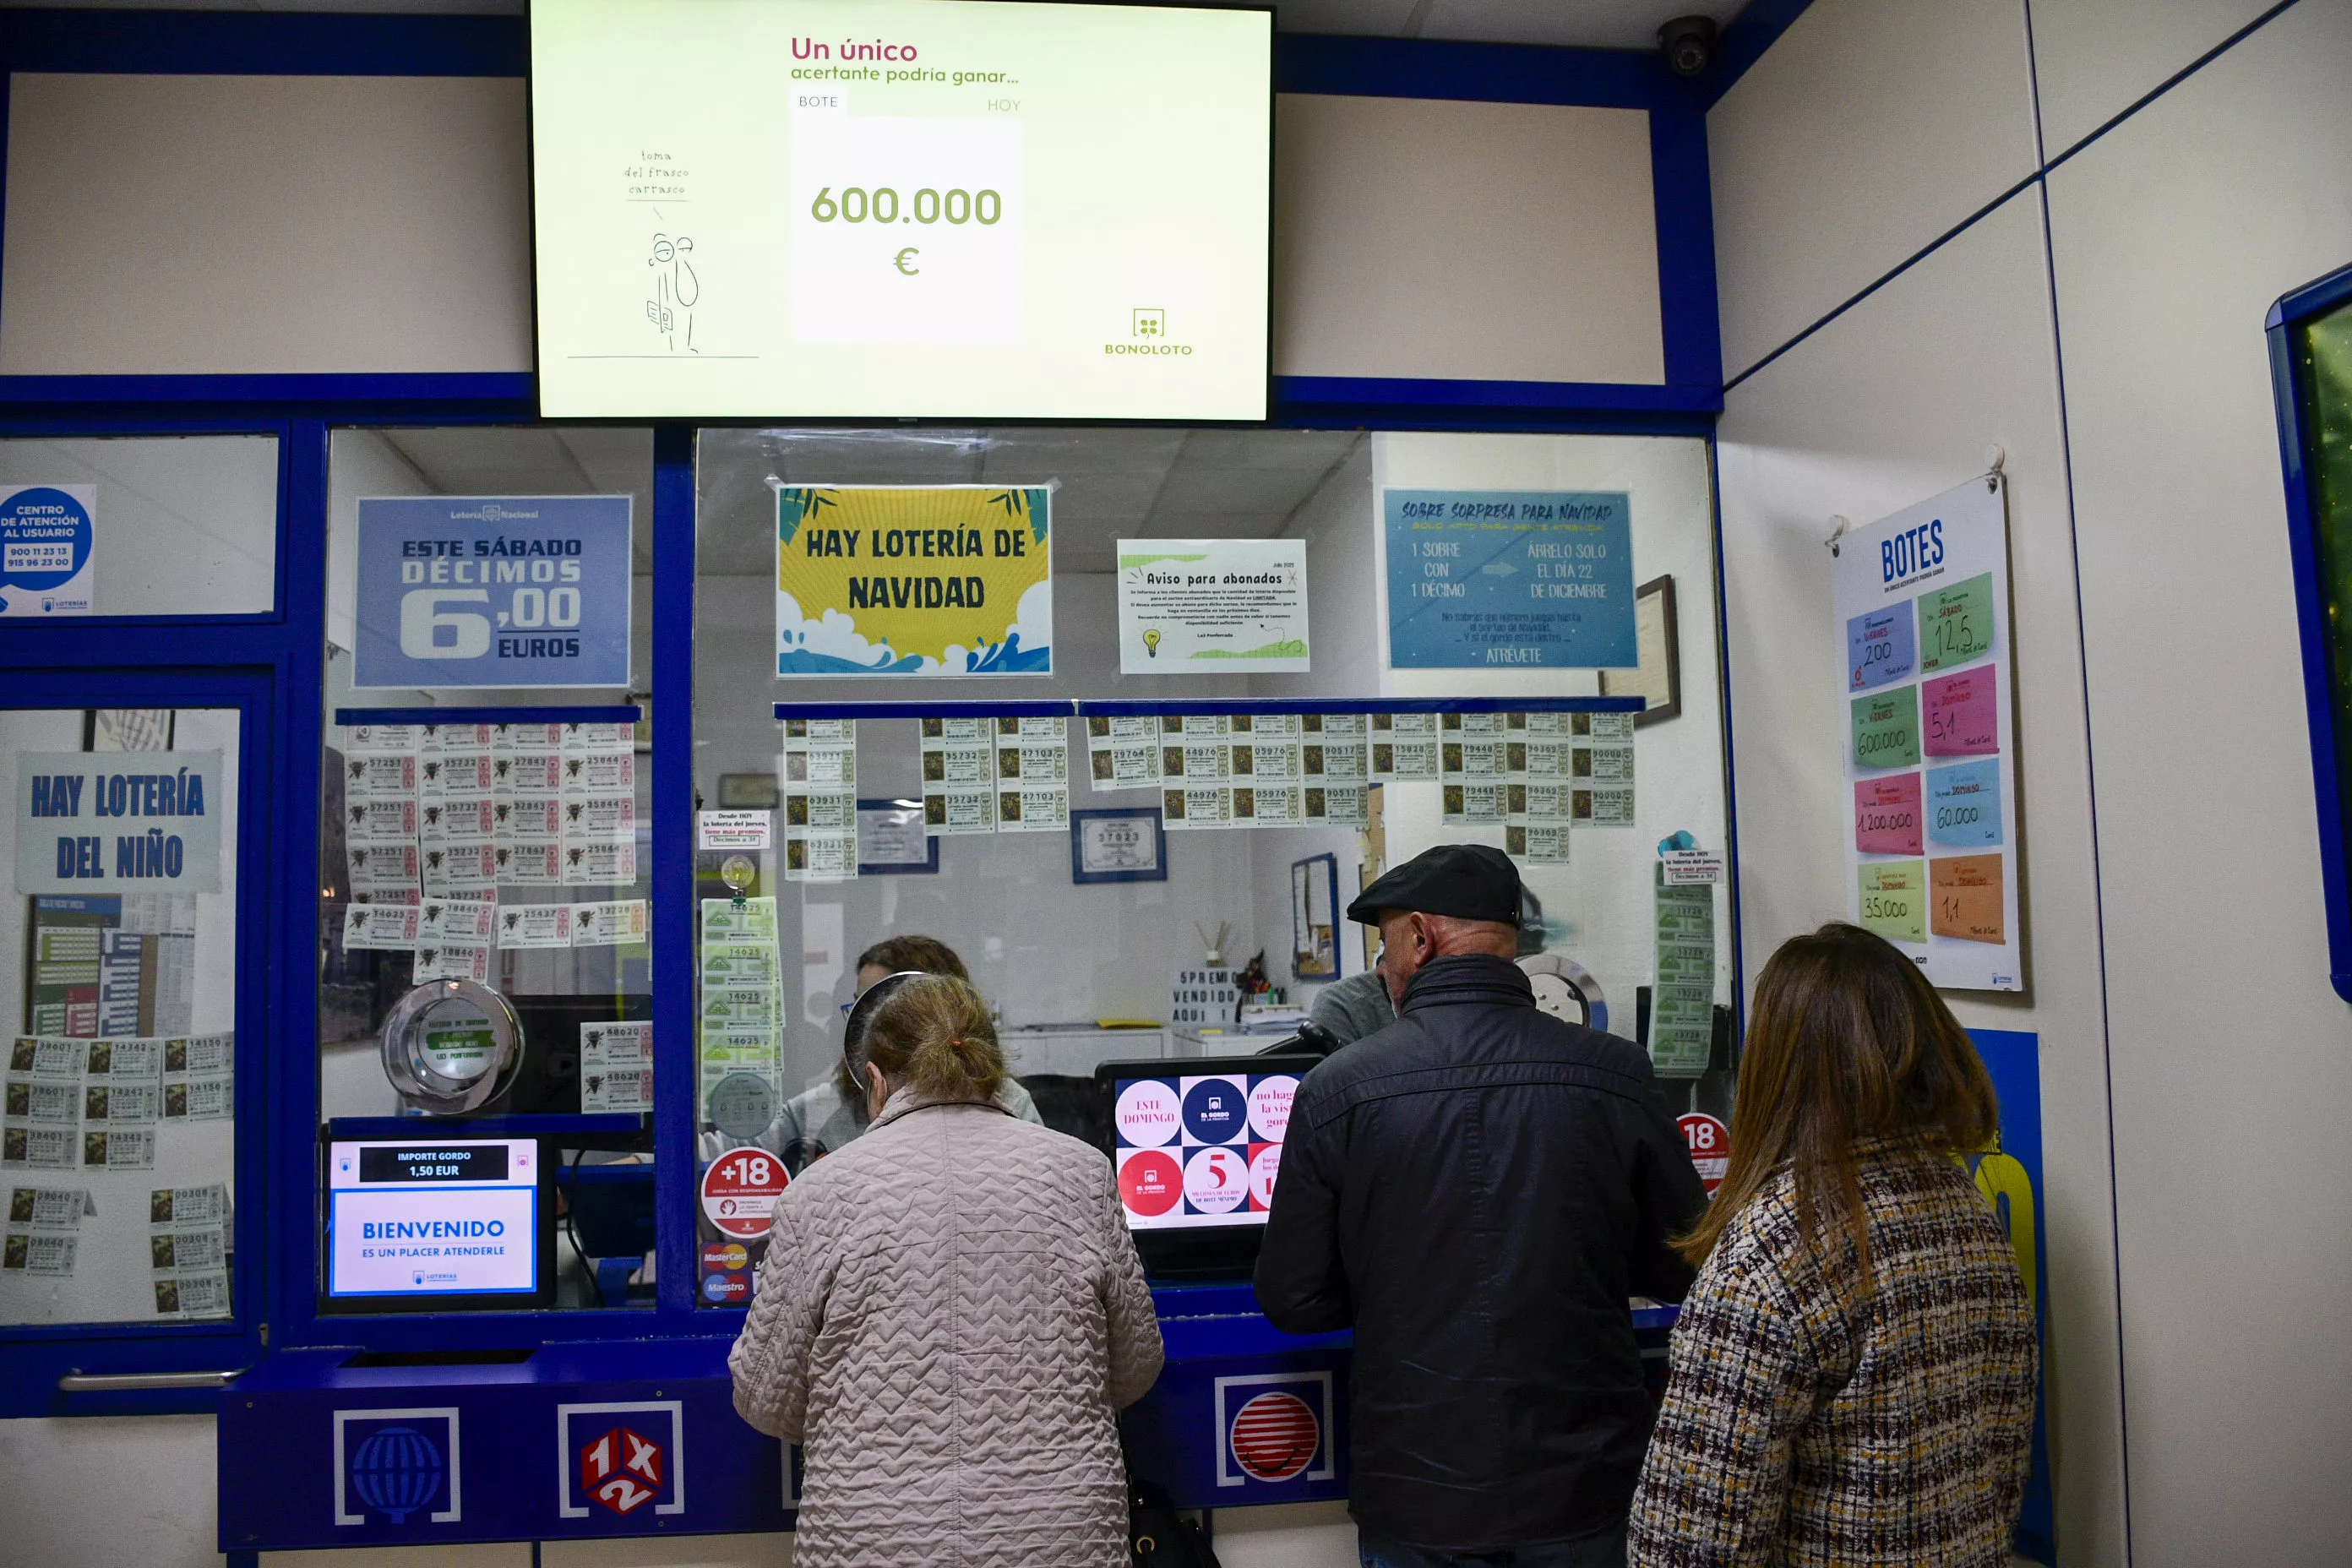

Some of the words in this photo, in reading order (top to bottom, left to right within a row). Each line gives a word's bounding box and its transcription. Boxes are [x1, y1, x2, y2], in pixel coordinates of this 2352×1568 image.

[792, 37, 830, 60] Un
[841, 38, 917, 62] único
[791, 65, 880, 80] acertante
[887, 67, 946, 84] podría
[952, 72, 1019, 86] ganar...
[799, 95, 838, 107] BOTE
[988, 99, 1021, 112] HOY
[641, 150, 672, 161] toma
[625, 167, 644, 178] del
[648, 167, 689, 178] frasco
[628, 184, 686, 194] carrasco
[811, 187, 1002, 226] 600.000
[893, 247, 920, 276] €
[1104, 344, 1193, 356] BONOLOTO
[16, 505, 65, 515] CENTRO
[500, 509, 539, 520] Nacional
[1402, 501, 1446, 519] SOBRE
[1451, 502, 1515, 520] SORPRESA
[1521, 504, 1554, 521] PARA
[1559, 504, 1612, 522] NAVIDAD
[0, 517, 17, 527] DE
[19, 515, 79, 526] ATENCIÓN
[3, 529, 19, 538] AL
[22, 528, 75, 537] USUARIO
[806, 528, 861, 558] HAY
[871, 522, 984, 558] LOTERÍA
[994, 529, 1026, 558] DE
[10, 548, 30, 557] 900
[58, 547, 68, 556] 13
[402, 540, 464, 558] ESTE
[474, 536, 582, 558] SÁBADO
[1412, 542, 1418, 558] 1
[1422, 542, 1462, 558] SOBRE
[1527, 538, 1573, 559] ÁBRELO
[1577, 544, 1607, 559] SOLO
[1881, 519, 1945, 584] BOTES
[8, 559, 24, 568] 915
[41, 558, 53, 567] 23
[56, 558, 69, 566] 00
[401, 555, 581, 584] DÉCIMOS
[1424, 562, 1450, 579] CON
[1537, 564, 1553, 579] EL
[1554, 560, 1576, 579] DÍA
[1578, 564, 1594, 580] 22
[1146, 571, 1180, 585] Aviso
[1187, 574, 1217, 587] para
[1222, 572, 1282, 585] abonados
[848, 576, 985, 609] NAVIDAD
[1412, 583, 1418, 598] 1
[1421, 579, 1467, 598] DÉCIMO
[1530, 584, 1544, 598] DE
[1548, 584, 1609, 599] DICIEMBRE
[1935, 614, 1973, 657] 12,5
[498, 638, 580, 659] EUROS
[1485, 645, 1543, 663] ATRÉVETE
[1864, 642, 1892, 667] 200
[1931, 710, 1954, 741] 5,1
[1395, 744, 1425, 754] 15828
[1463, 744, 1494, 754] 79448
[1858, 730, 1905, 756] 600.000
[945, 751, 977, 761] 35732
[1020, 749, 1054, 760] 47103
[1113, 748, 1145, 760] 29764
[1184, 748, 1217, 758] 44976
[1255, 746, 1286, 756] 05976
[1324, 746, 1356, 755] 90517
[30, 774, 84, 818] HAY
[95, 765, 205, 817] LOTERÍA
[1186, 790, 1218, 799] 44976
[1255, 789, 1287, 798] 05976
[1326, 788, 1357, 798] 90517
[1465, 786, 1494, 796] 79448
[808, 796, 841, 805] 63931
[946, 795, 979, 805] 35732
[1021, 792, 1054, 803] 47103
[1937, 806, 1979, 830] 60.000
[56, 836, 104, 879] DEL
[116, 827, 184, 879] NIÑO
[1865, 897, 1908, 919] 35.000
[1942, 896, 1959, 923] 1,1
[728, 947, 760, 956] 14625
[728, 992, 760, 1001] 14625
[1173, 989, 1235, 1004] VENDIDO
[727, 1036, 760, 1046] 14625
[1256, 1092, 1271, 1101] no
[1273, 1089, 1295, 1103] hag
[1136, 1099, 1162, 1111] ESTE
[1260, 1103, 1271, 1113] la
[1124, 1113, 1176, 1124] DOMINGO
[1683, 1122, 1715, 1150] 18
[398, 1152, 437, 1162] IMPORTE
[439, 1151, 471, 1161] GORDO
[409, 1165, 433, 1178] 1,50
[436, 1164, 460, 1177] EUR
[721, 1157, 770, 1186] +18
[1208, 1154, 1227, 1190] 5
[362, 1219, 505, 1239] BIENVENIDO
[362, 1248, 375, 1258] ES
[378, 1248, 395, 1258] UN
[399, 1247, 440, 1257] PLACER
[443, 1246, 505, 1256] ATENDERLE
[704, 1252, 748, 1262] MasterCard
[707, 1282, 745, 1292] Maestro
